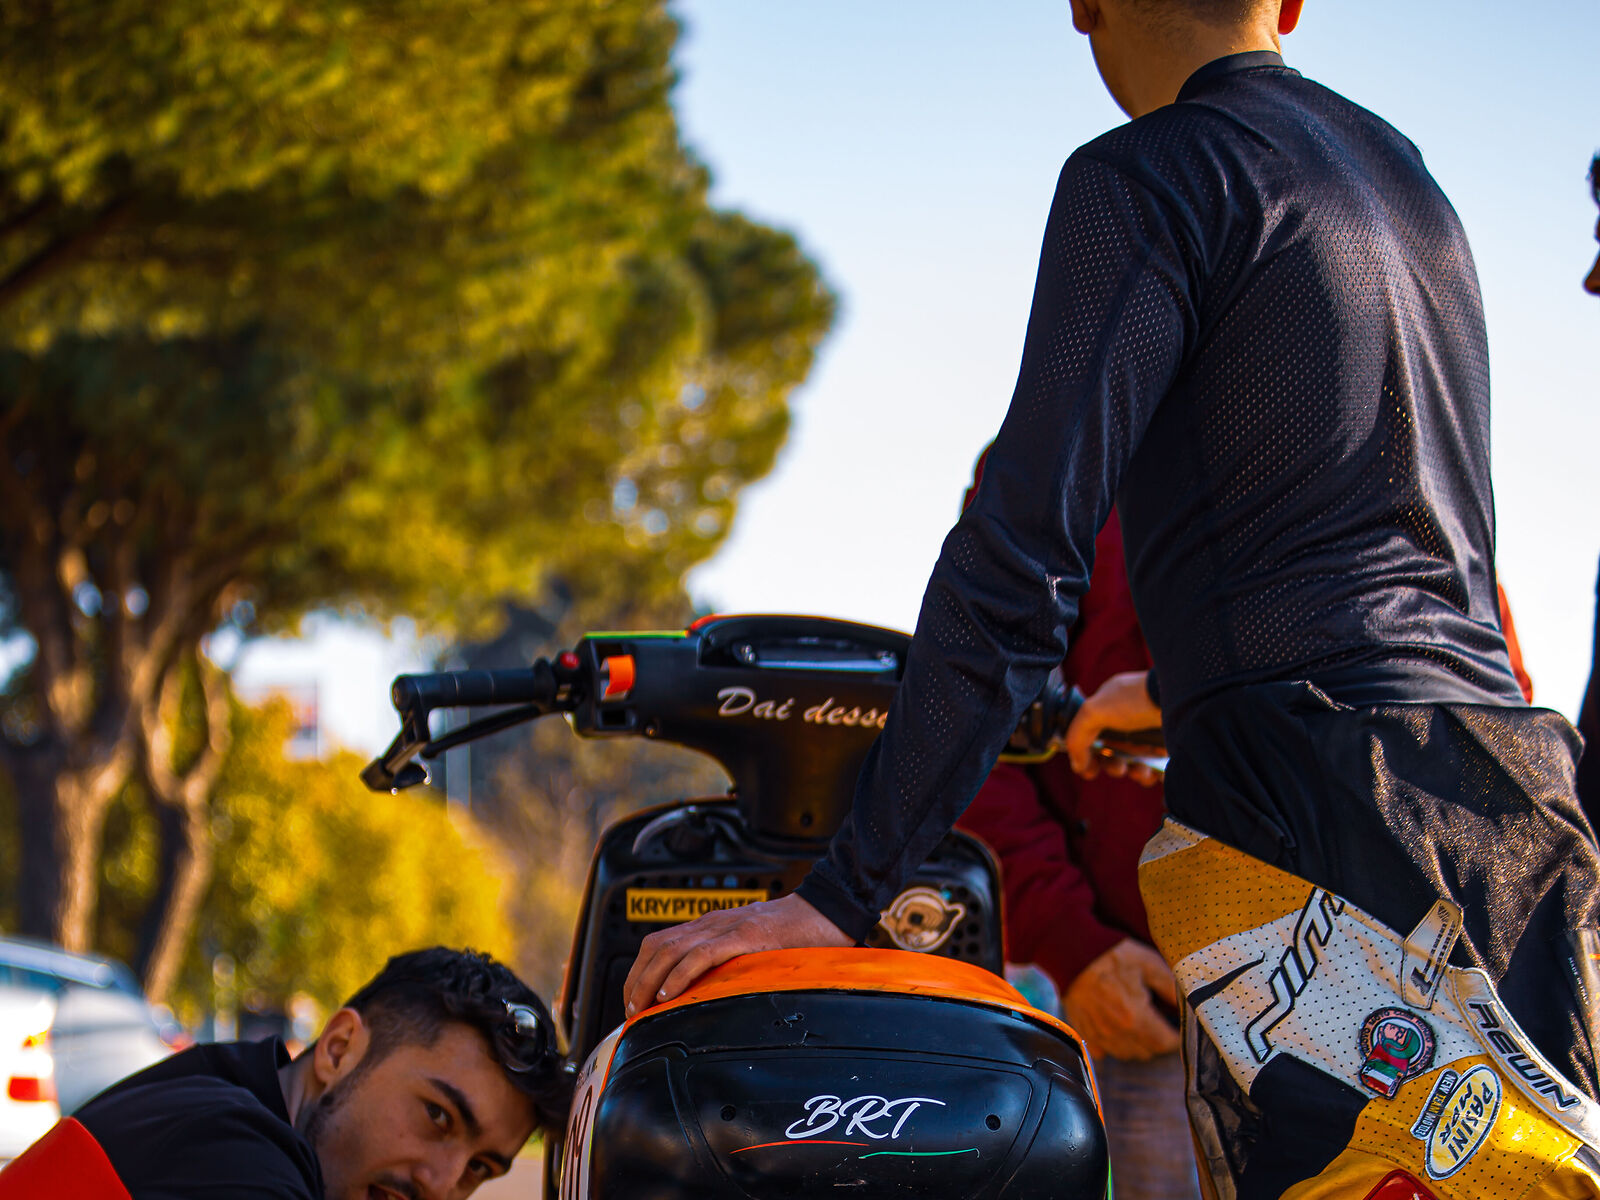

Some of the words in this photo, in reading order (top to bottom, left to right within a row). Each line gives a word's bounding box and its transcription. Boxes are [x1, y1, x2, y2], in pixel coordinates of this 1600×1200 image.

[717, 686, 795, 720] Dai
[1466, 1001, 1581, 1109] REWIN
[1427, 1092, 1447, 1114] TEAM
[1438, 1073, 1456, 1096] NEW
[785, 1095, 947, 1140] BRT
[1447, 1081, 1494, 1162] PASINI
